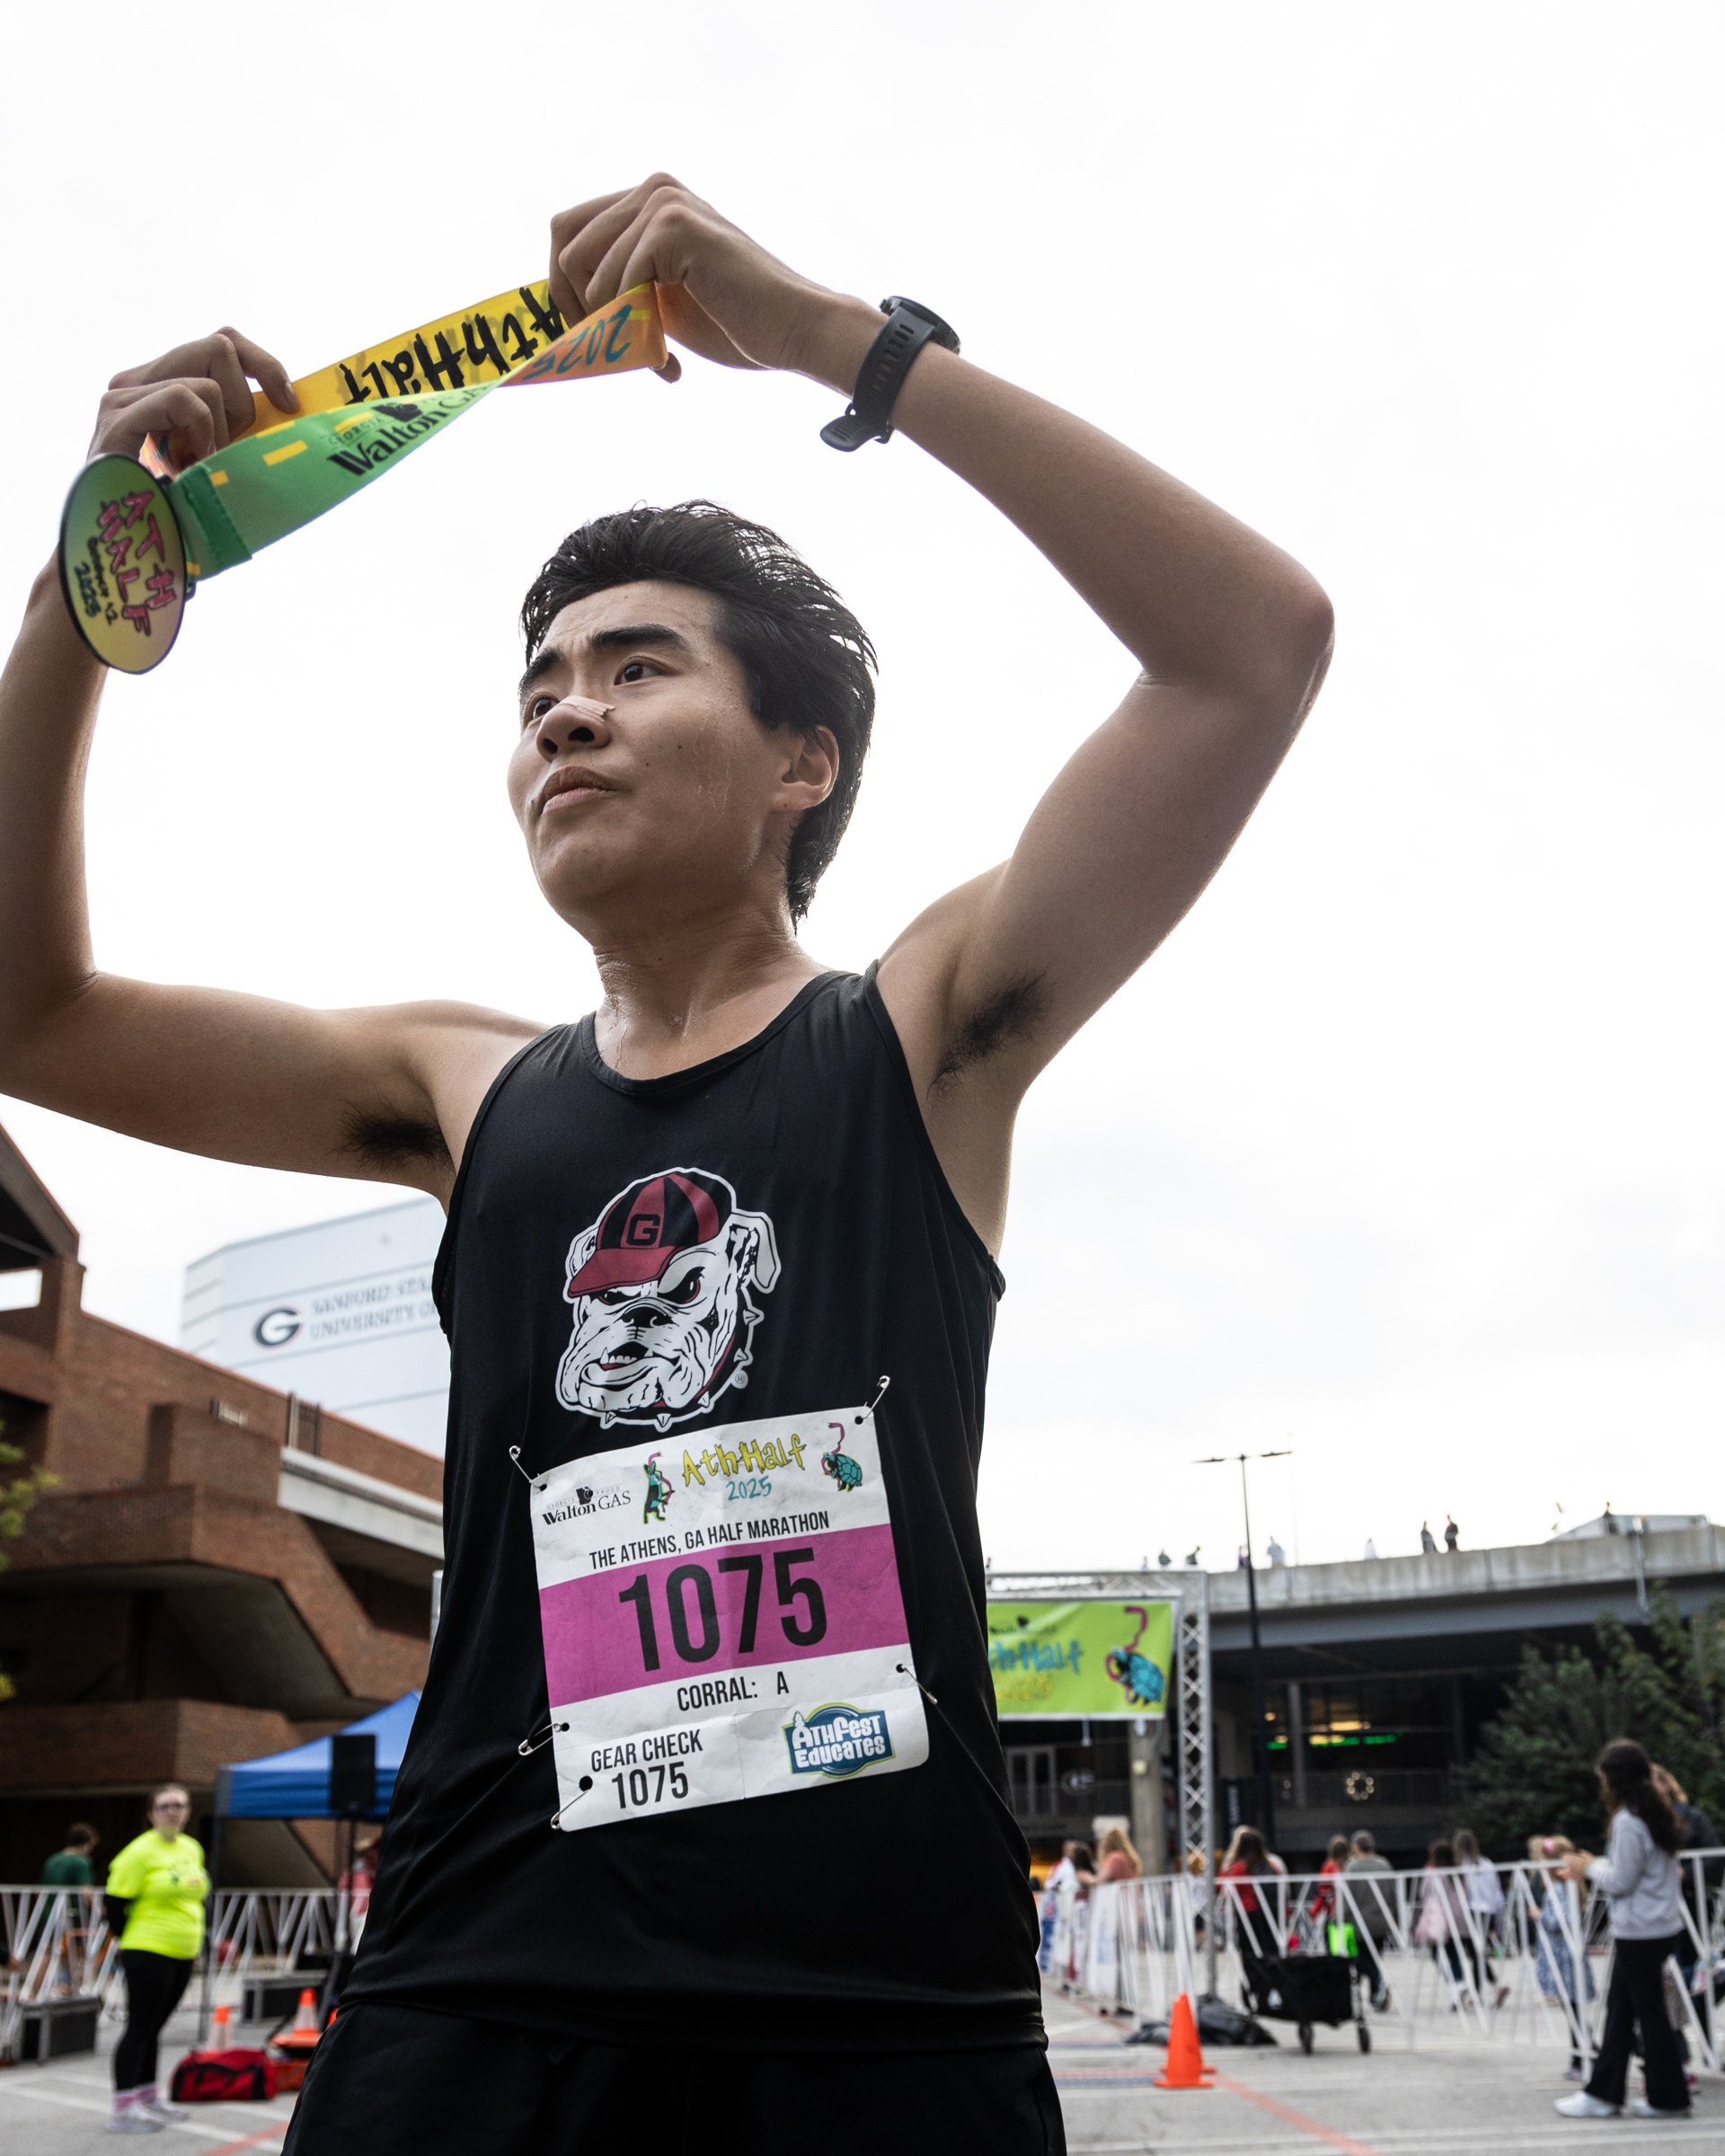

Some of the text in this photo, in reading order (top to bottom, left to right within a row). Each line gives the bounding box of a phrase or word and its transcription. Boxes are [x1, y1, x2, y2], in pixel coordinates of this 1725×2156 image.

[522, 304, 632, 381] 2025
[326, 409, 451, 477] Walton
[98, 499, 153, 637] HALF
[122, 490, 177, 611] ATH
[625, 1214, 661, 1246] G
[395, 1275, 431, 1297] STA
[252, 1306, 302, 1348] G
[682, 1433, 807, 1488] AthHalf
[542, 1490, 632, 1525] Walton GAS
[546, 1485, 621, 1509] GEORGIA PROUD
[725, 1474, 772, 1501] 2025
[589, 1511, 830, 1569] THE ATHENS, GA HALF MARATHON
[618, 1547, 827, 1673] 1075
[677, 1671, 790, 1711] CORRAL: A
[591, 1729, 703, 1772] GEAR CHECK
[612, 1761, 689, 1809] 1075
